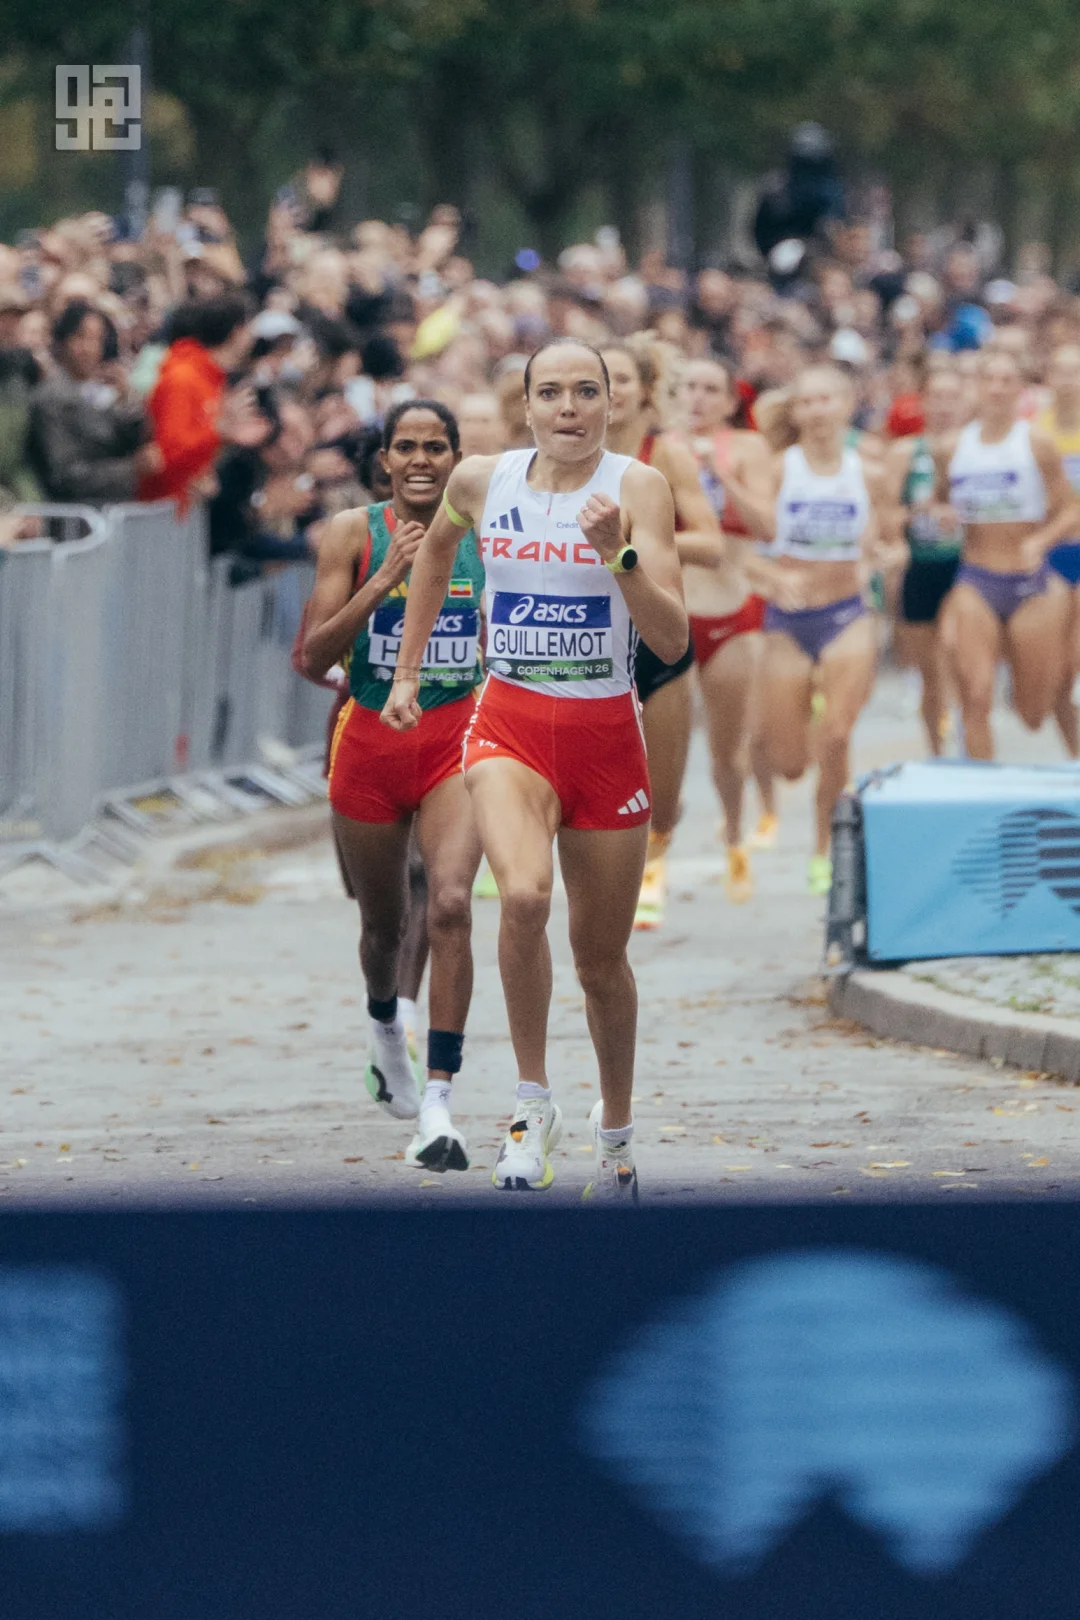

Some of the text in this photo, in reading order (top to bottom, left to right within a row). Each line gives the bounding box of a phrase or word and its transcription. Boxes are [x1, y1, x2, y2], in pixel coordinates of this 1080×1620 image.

[480, 537, 604, 566] FRANC
[533, 602, 587, 623] asics
[381, 639, 468, 664] HILU
[493, 628, 606, 657] GUILLEMOT
[516, 663, 609, 676] COPENHAGEN 26
